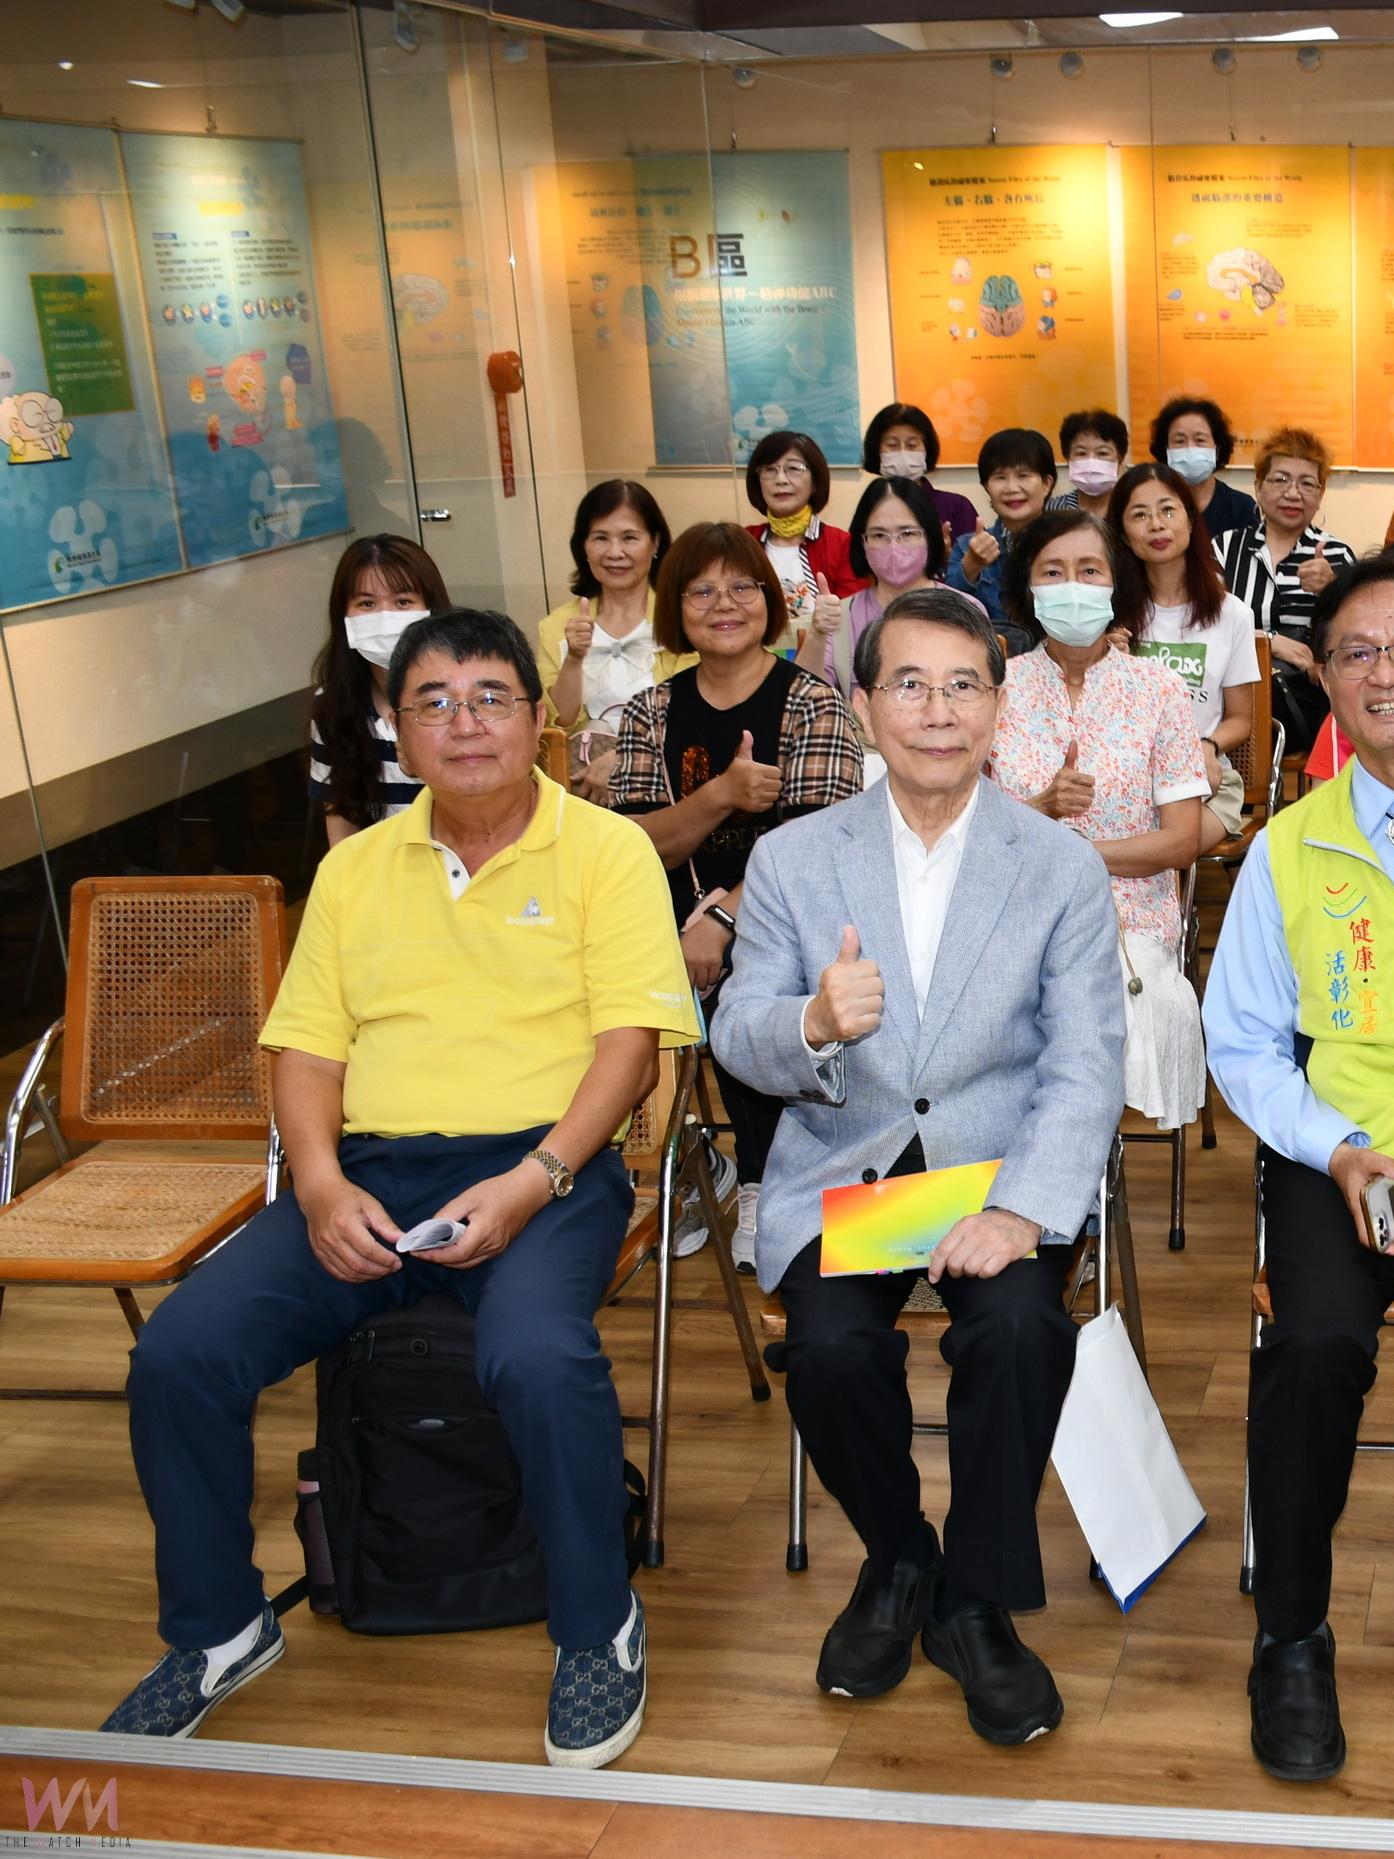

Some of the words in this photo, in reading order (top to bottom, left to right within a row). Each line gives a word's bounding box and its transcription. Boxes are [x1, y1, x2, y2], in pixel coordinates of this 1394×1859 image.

[669, 233, 748, 279] B區
[1325, 950, 1354, 1031] 活彰化
